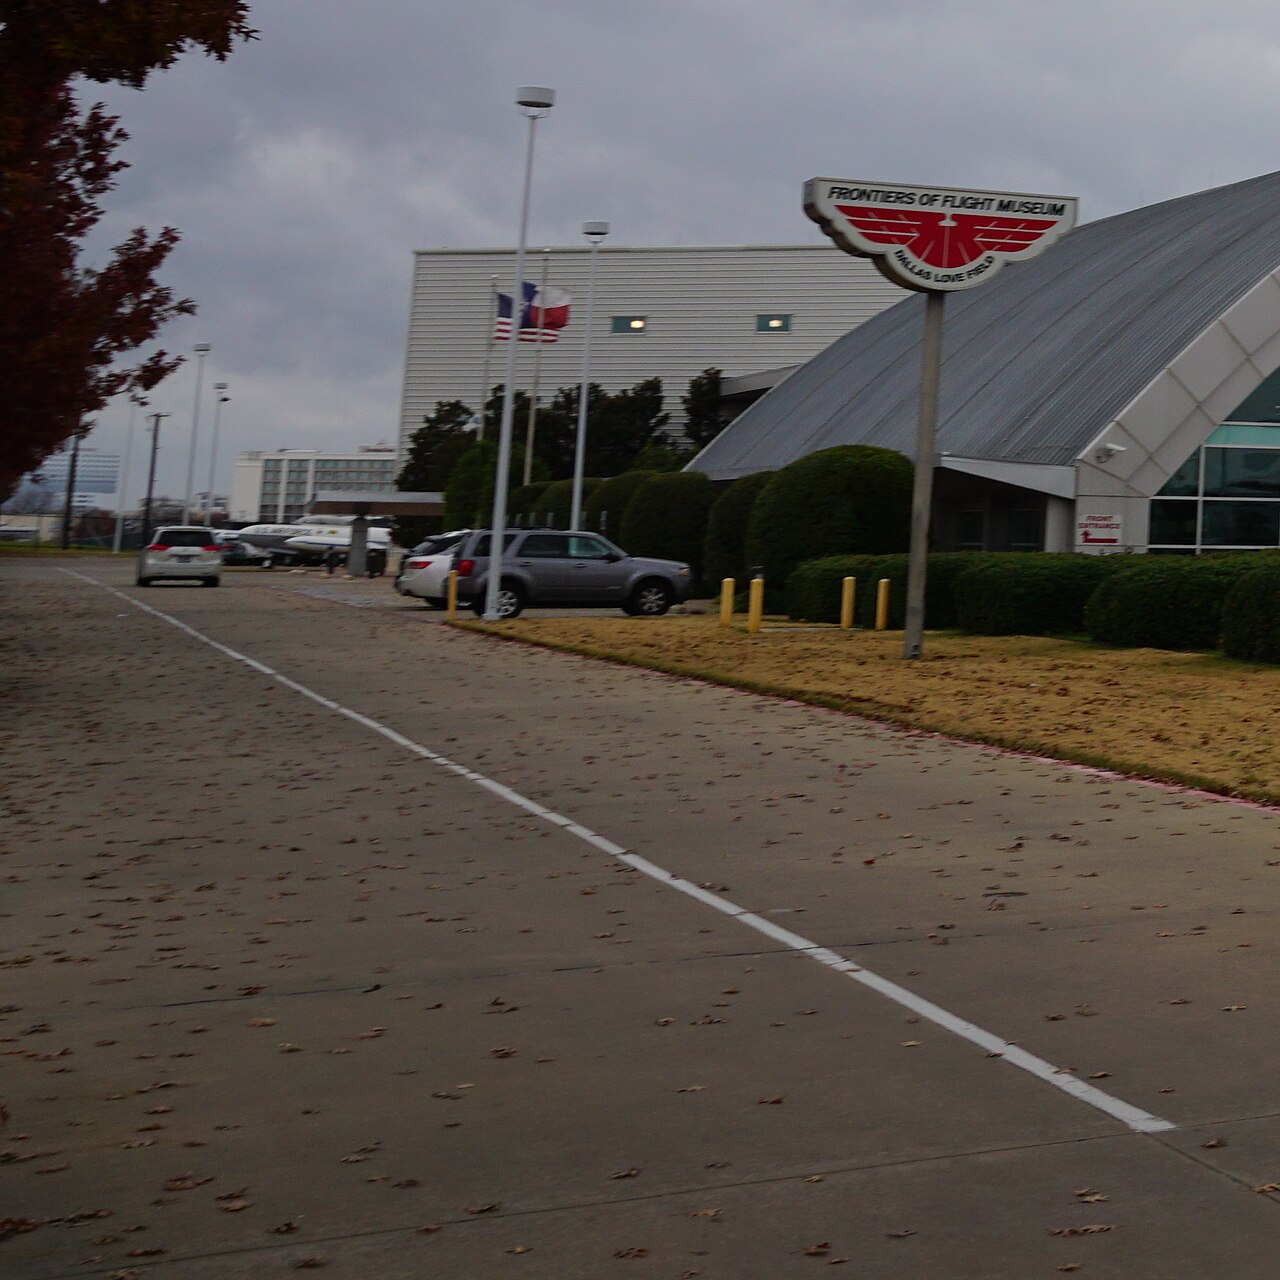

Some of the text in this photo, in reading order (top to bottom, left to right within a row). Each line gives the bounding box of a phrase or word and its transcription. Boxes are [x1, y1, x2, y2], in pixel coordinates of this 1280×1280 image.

[827, 186, 1065, 216] FRONTIERS OF FLIGHT MUSEUM
[894, 249, 995, 283] DALLAS LOVE FIELD
